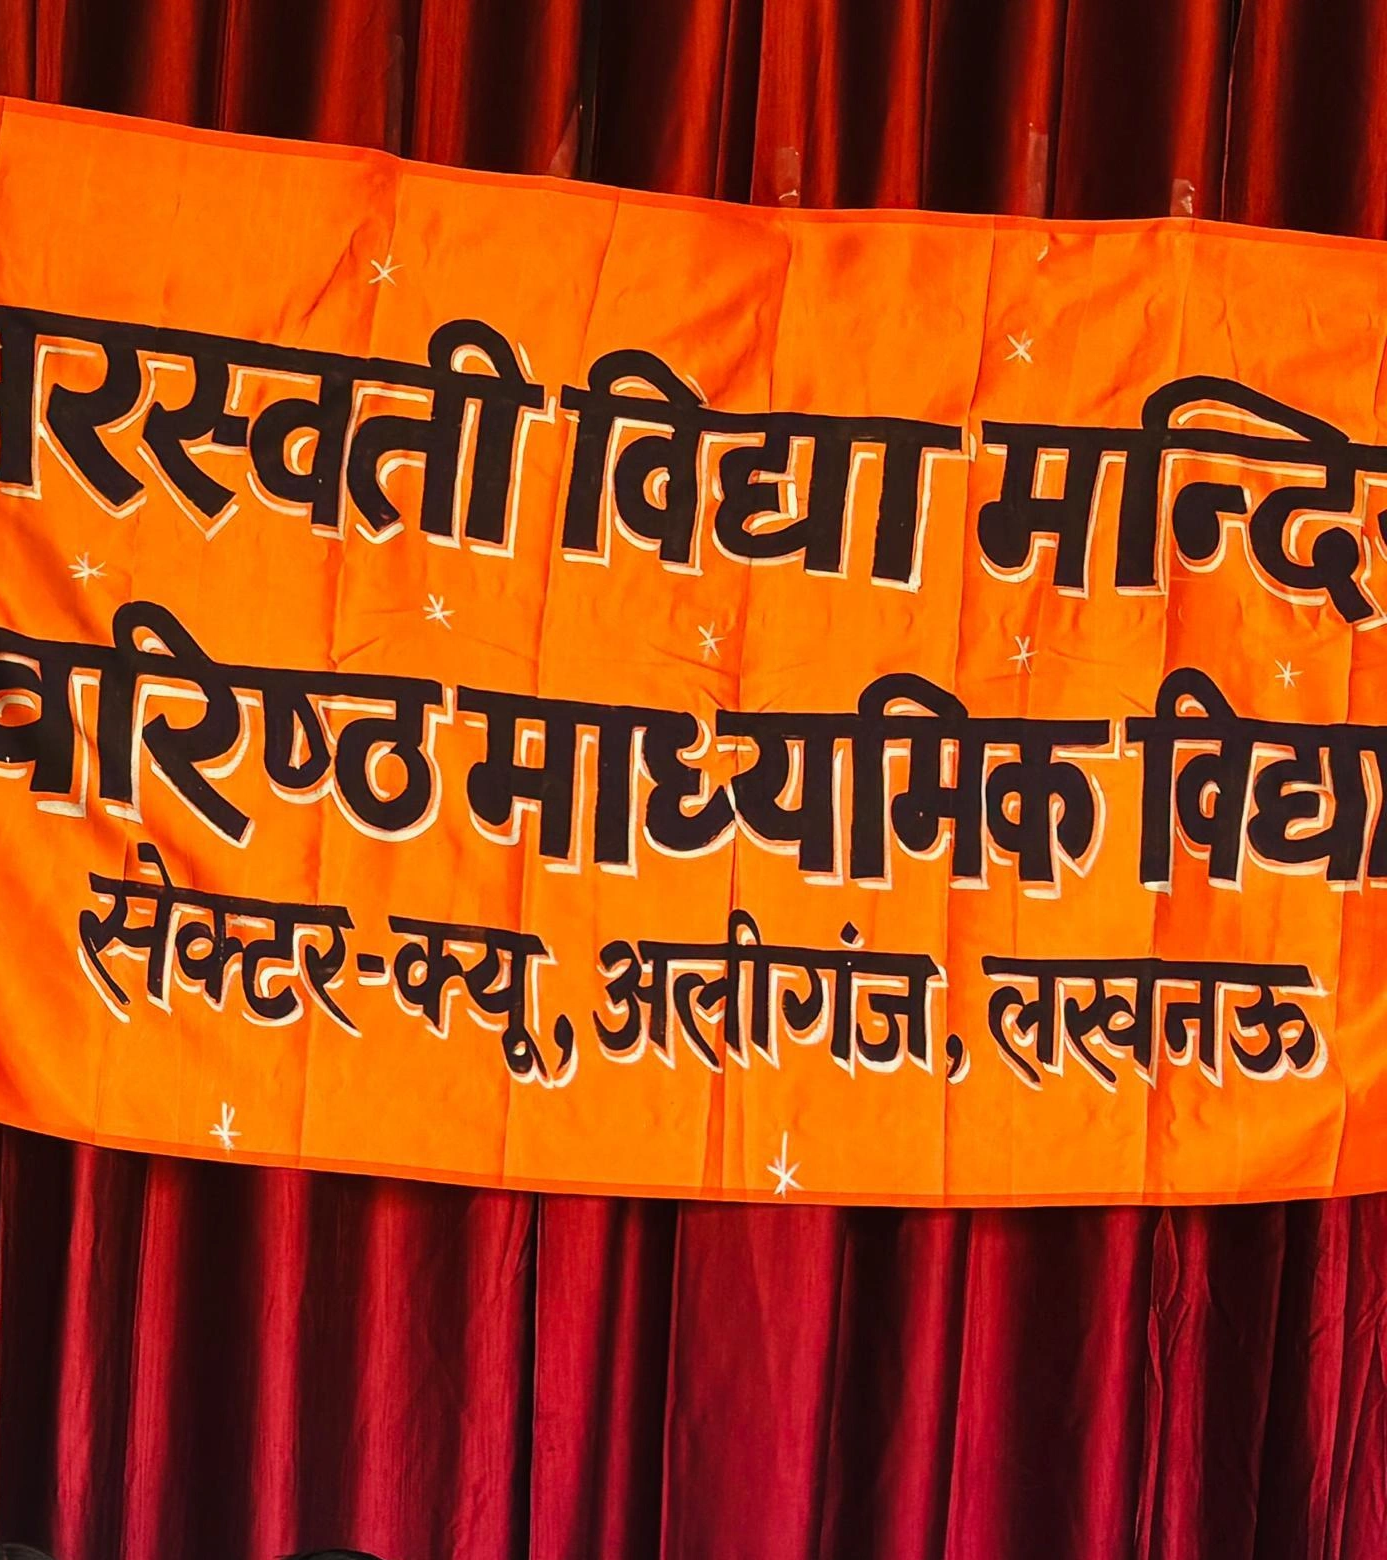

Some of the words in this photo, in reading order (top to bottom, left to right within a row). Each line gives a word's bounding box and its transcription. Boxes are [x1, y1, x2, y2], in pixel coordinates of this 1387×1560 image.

[560, 348, 971, 594] विद्या
[978, 375, 1387, 628] मन्दि
[457, 673, 1121, 891] माध्यमिक
[981, 956, 1332, 1093] लखनऊ
